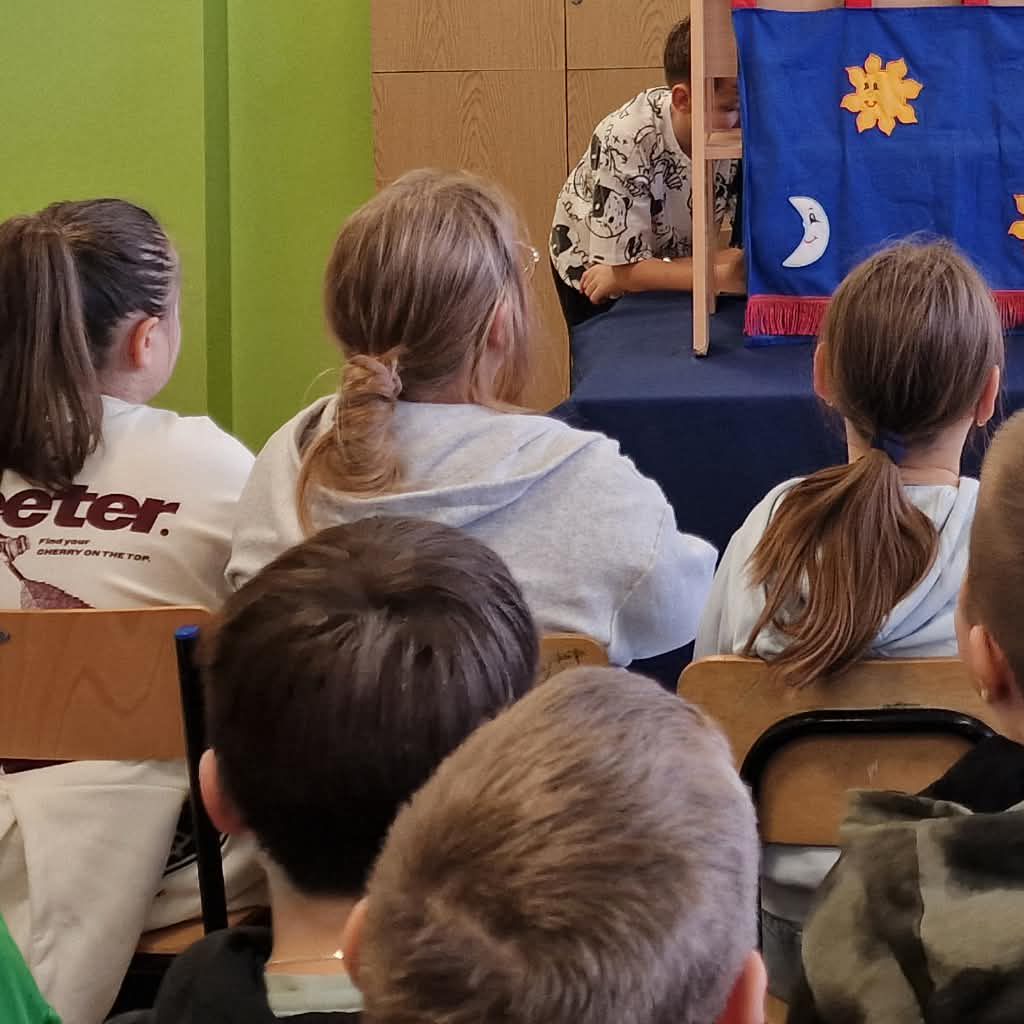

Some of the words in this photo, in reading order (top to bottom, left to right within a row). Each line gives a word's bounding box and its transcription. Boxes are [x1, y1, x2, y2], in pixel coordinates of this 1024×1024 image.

[0, 484, 182, 537] eter.
[38, 537, 64, 546] Find
[64, 539, 91, 547] your
[36, 548, 84, 556] CHERRY
[84, 549, 101, 557] ON
[102, 550, 126, 560] THE
